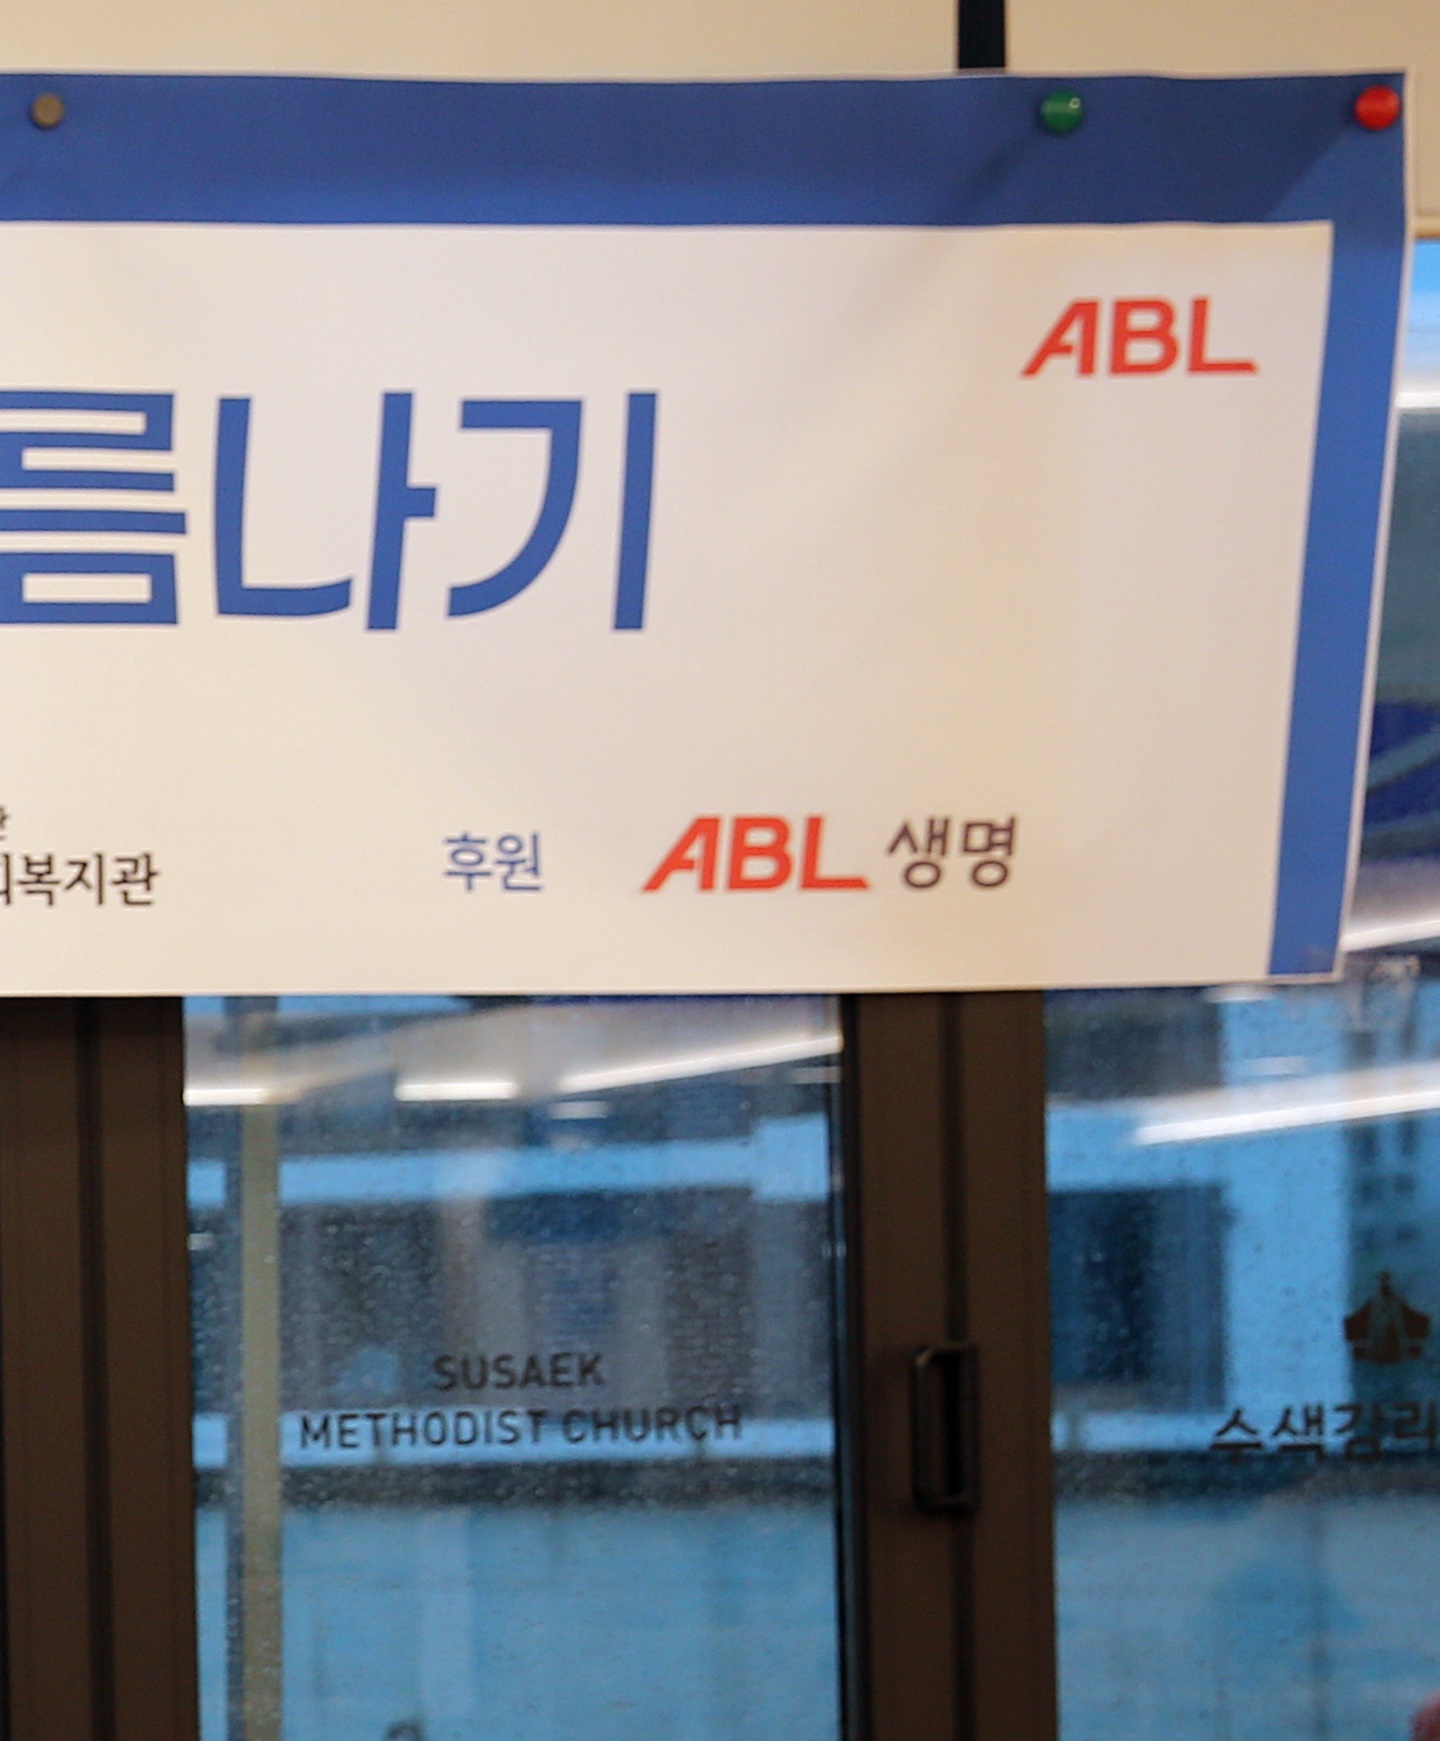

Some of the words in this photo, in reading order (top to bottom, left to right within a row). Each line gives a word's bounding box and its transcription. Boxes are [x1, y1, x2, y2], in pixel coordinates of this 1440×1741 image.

[1022, 297, 1257, 377] ABL
[444, 833, 542, 891] 후원
[643, 816, 870, 892] ABL
[888, 817, 1016, 890] 생명
[434, 1352, 605, 1391] SUSAEK
[300, 1409, 545, 1450] METHODIST
[562, 1405, 742, 1444] CHURCH
